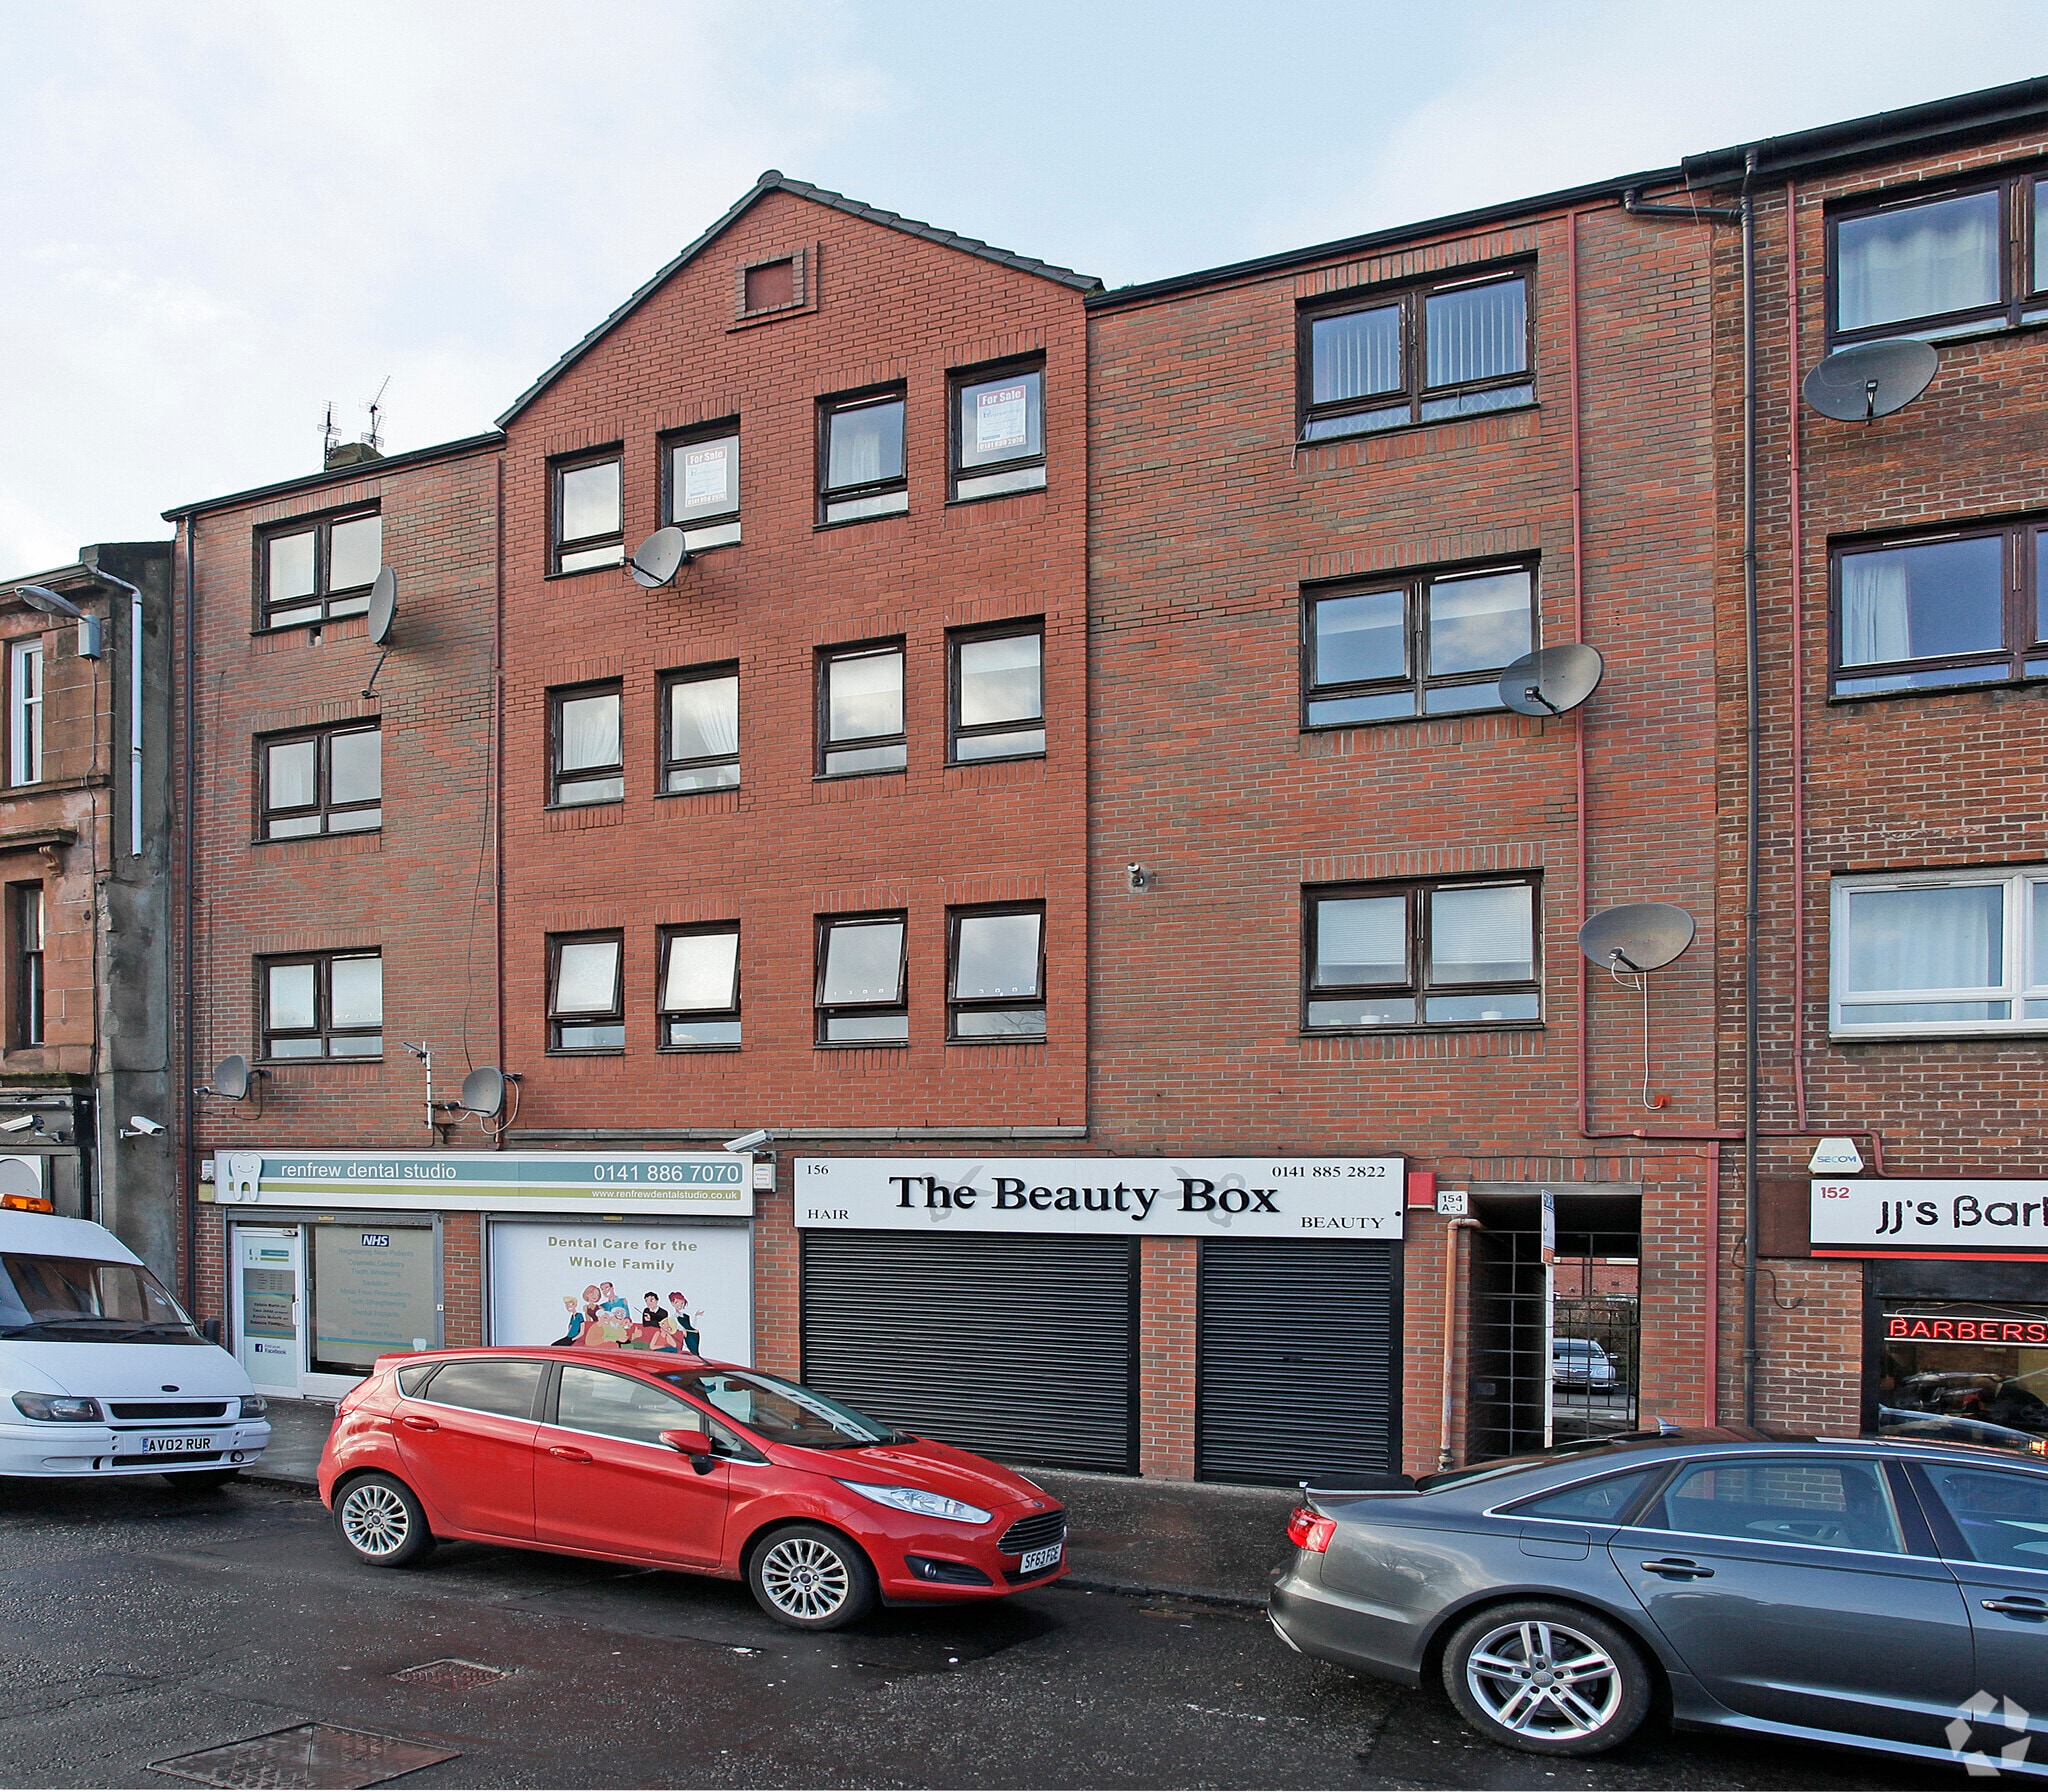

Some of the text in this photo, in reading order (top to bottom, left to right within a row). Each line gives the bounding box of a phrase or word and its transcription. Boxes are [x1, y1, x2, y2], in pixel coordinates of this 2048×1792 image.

[982, 390, 1021, 405] For Sale
[690, 450, 723, 465] For Sale
[1816, 1155, 1857, 1163] SECOM
[281, 1162, 457, 1179] renfrew dental studio
[594, 1164, 638, 1181] 0141
[647, 1165, 683, 1181] 886
[690, 1165, 739, 1182] 7070
[807, 1164, 829, 1175] 156
[1272, 1166, 1386, 1178] 0141 885 2822
[592, 1189, 737, 1200] www.renfrewdentalstudio.co.uk
[889, 1176, 1280, 1221] The Beauty Box
[1820, 1186, 1850, 1199] 152
[807, 1208, 850, 1220] HAIR
[1300, 1217, 1385, 1229] BEAUTY
[363, 1235, 389, 1246] NHS
[548, 1236, 698, 1251] Dental Care for the
[569, 1256, 675, 1273] Whole Family
[1889, 1319, 2047, 1343] BARBERS
[149, 1437, 211, 1451] AV02 RUR
[1025, 1551, 1046, 1568] SF63
